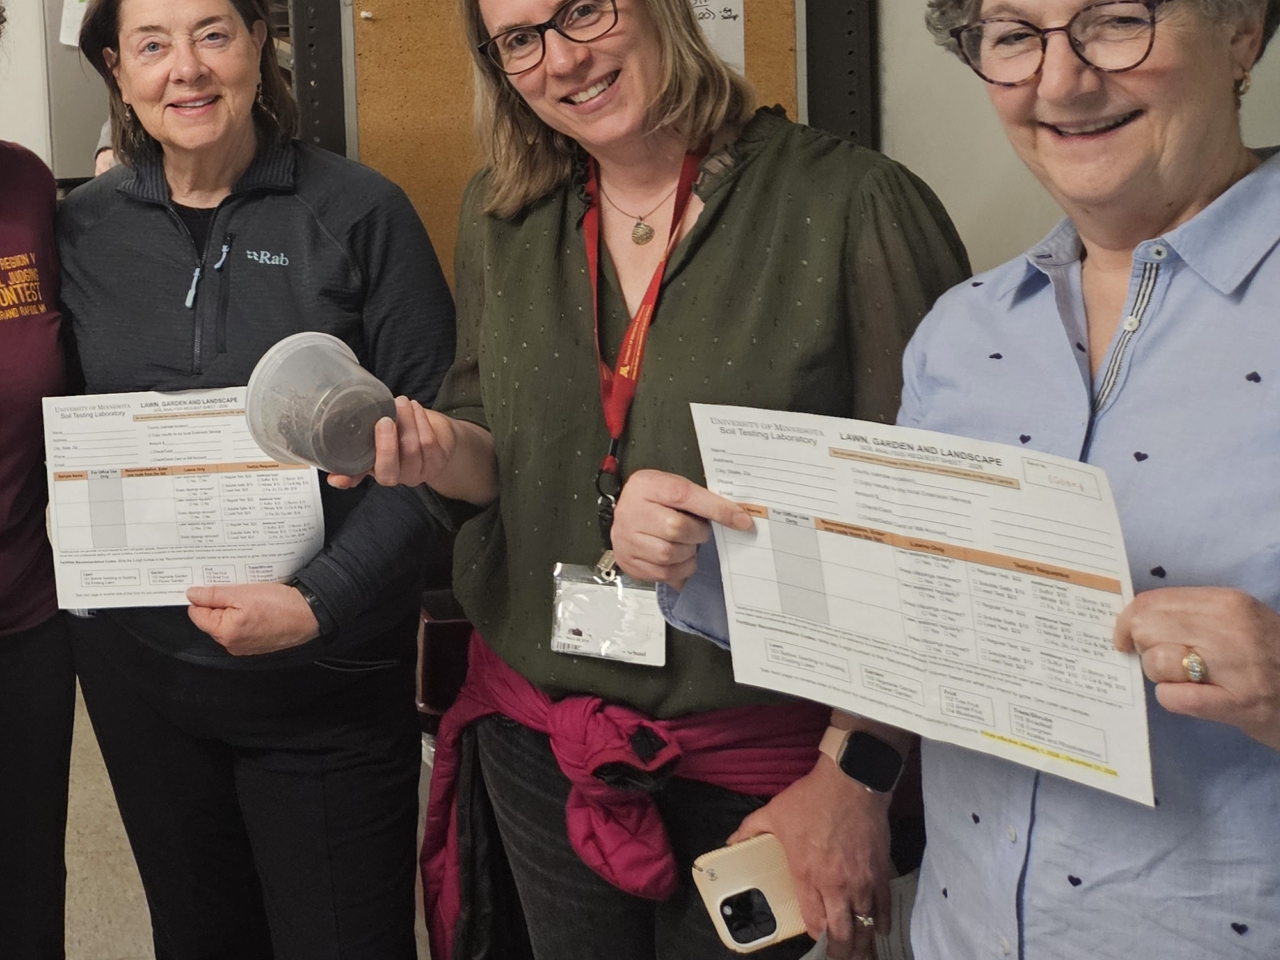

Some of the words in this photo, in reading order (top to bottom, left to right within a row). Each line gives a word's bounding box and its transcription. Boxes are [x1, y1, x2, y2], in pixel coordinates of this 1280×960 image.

[258, 250, 290, 266] Rab
[8, 268, 40, 284] JUDGING
[162, 400, 188, 408] GARDEN
[202, 396, 238, 405] LANDSCAPE
[720, 426, 736, 436] Soil
[738, 428, 770, 440] Testing
[770, 432, 818, 446] Laboratory
[872, 437, 916, 452] GARDEN
[917, 444, 938, 455] AND
[940, 448, 1003, 466] LANDSCAPE
[944, 689, 956, 697] Fruit
[1013, 708, 1052, 722] Trees/Shrubs
